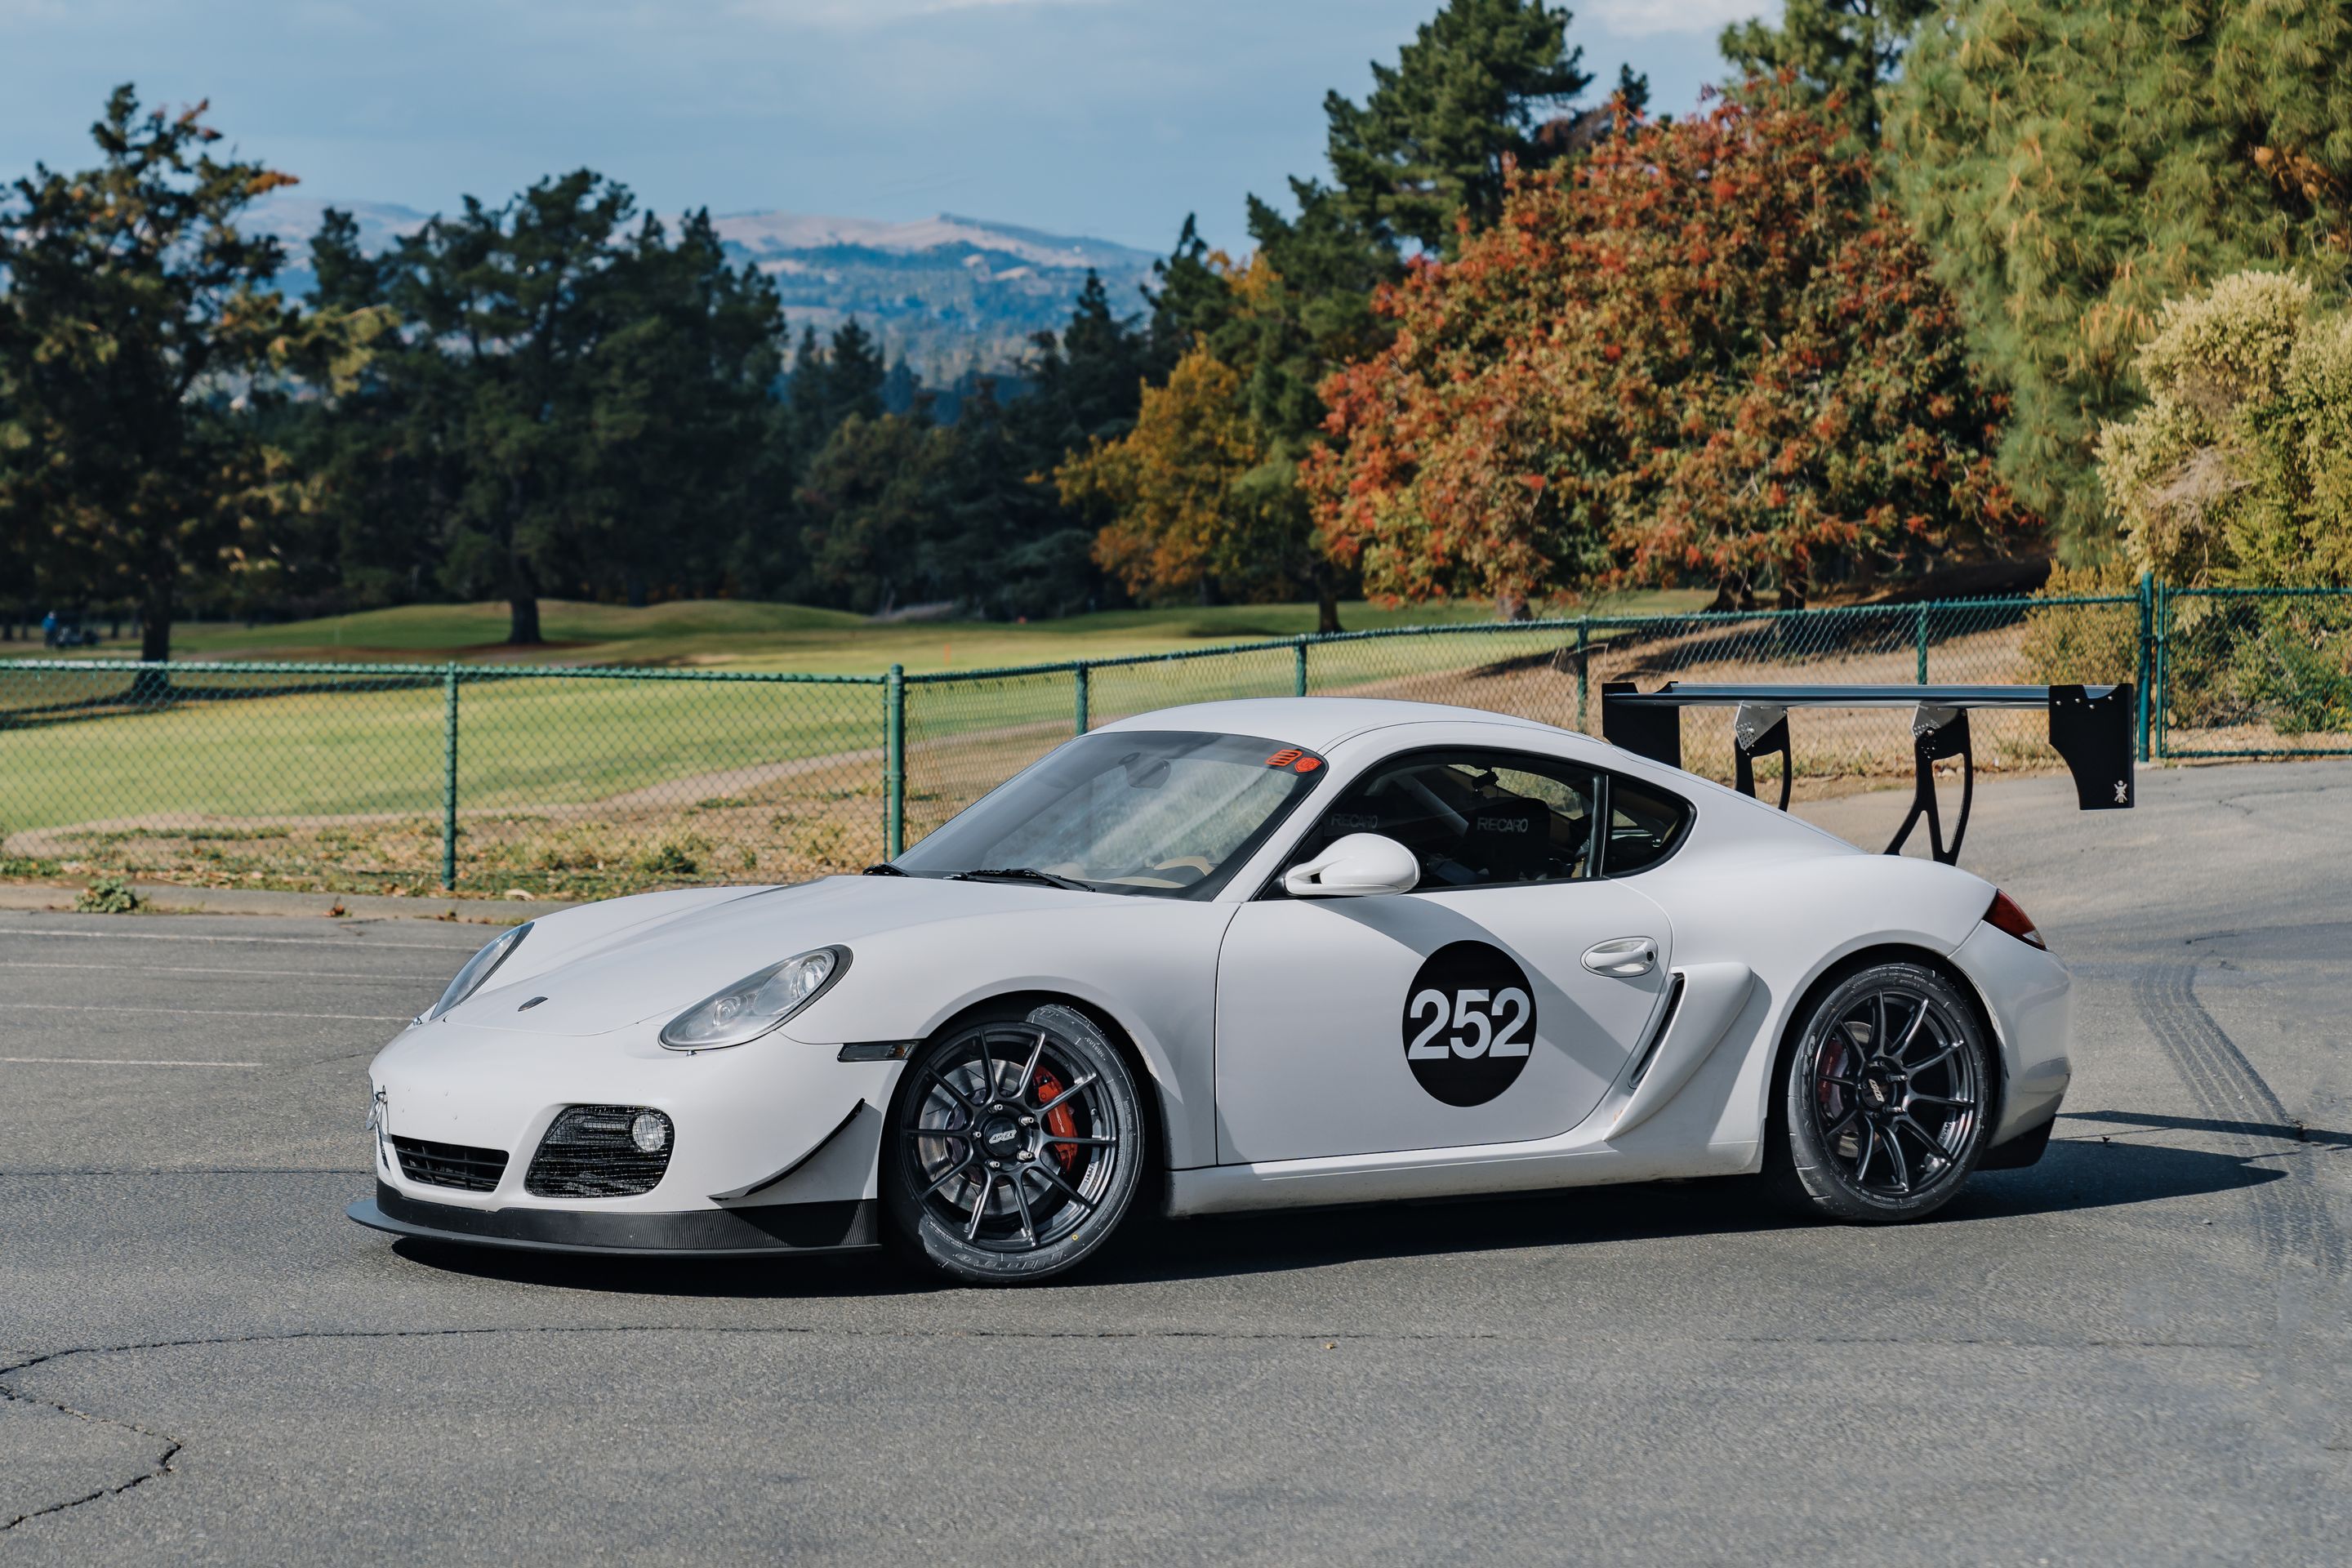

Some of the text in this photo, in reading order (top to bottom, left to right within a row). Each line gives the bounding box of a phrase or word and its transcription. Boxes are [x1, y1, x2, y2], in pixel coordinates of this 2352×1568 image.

[1477, 817, 1529, 832] RECARO
[1407, 987, 1530, 1060] 252
[989, 1129, 1017, 1144] APEX
